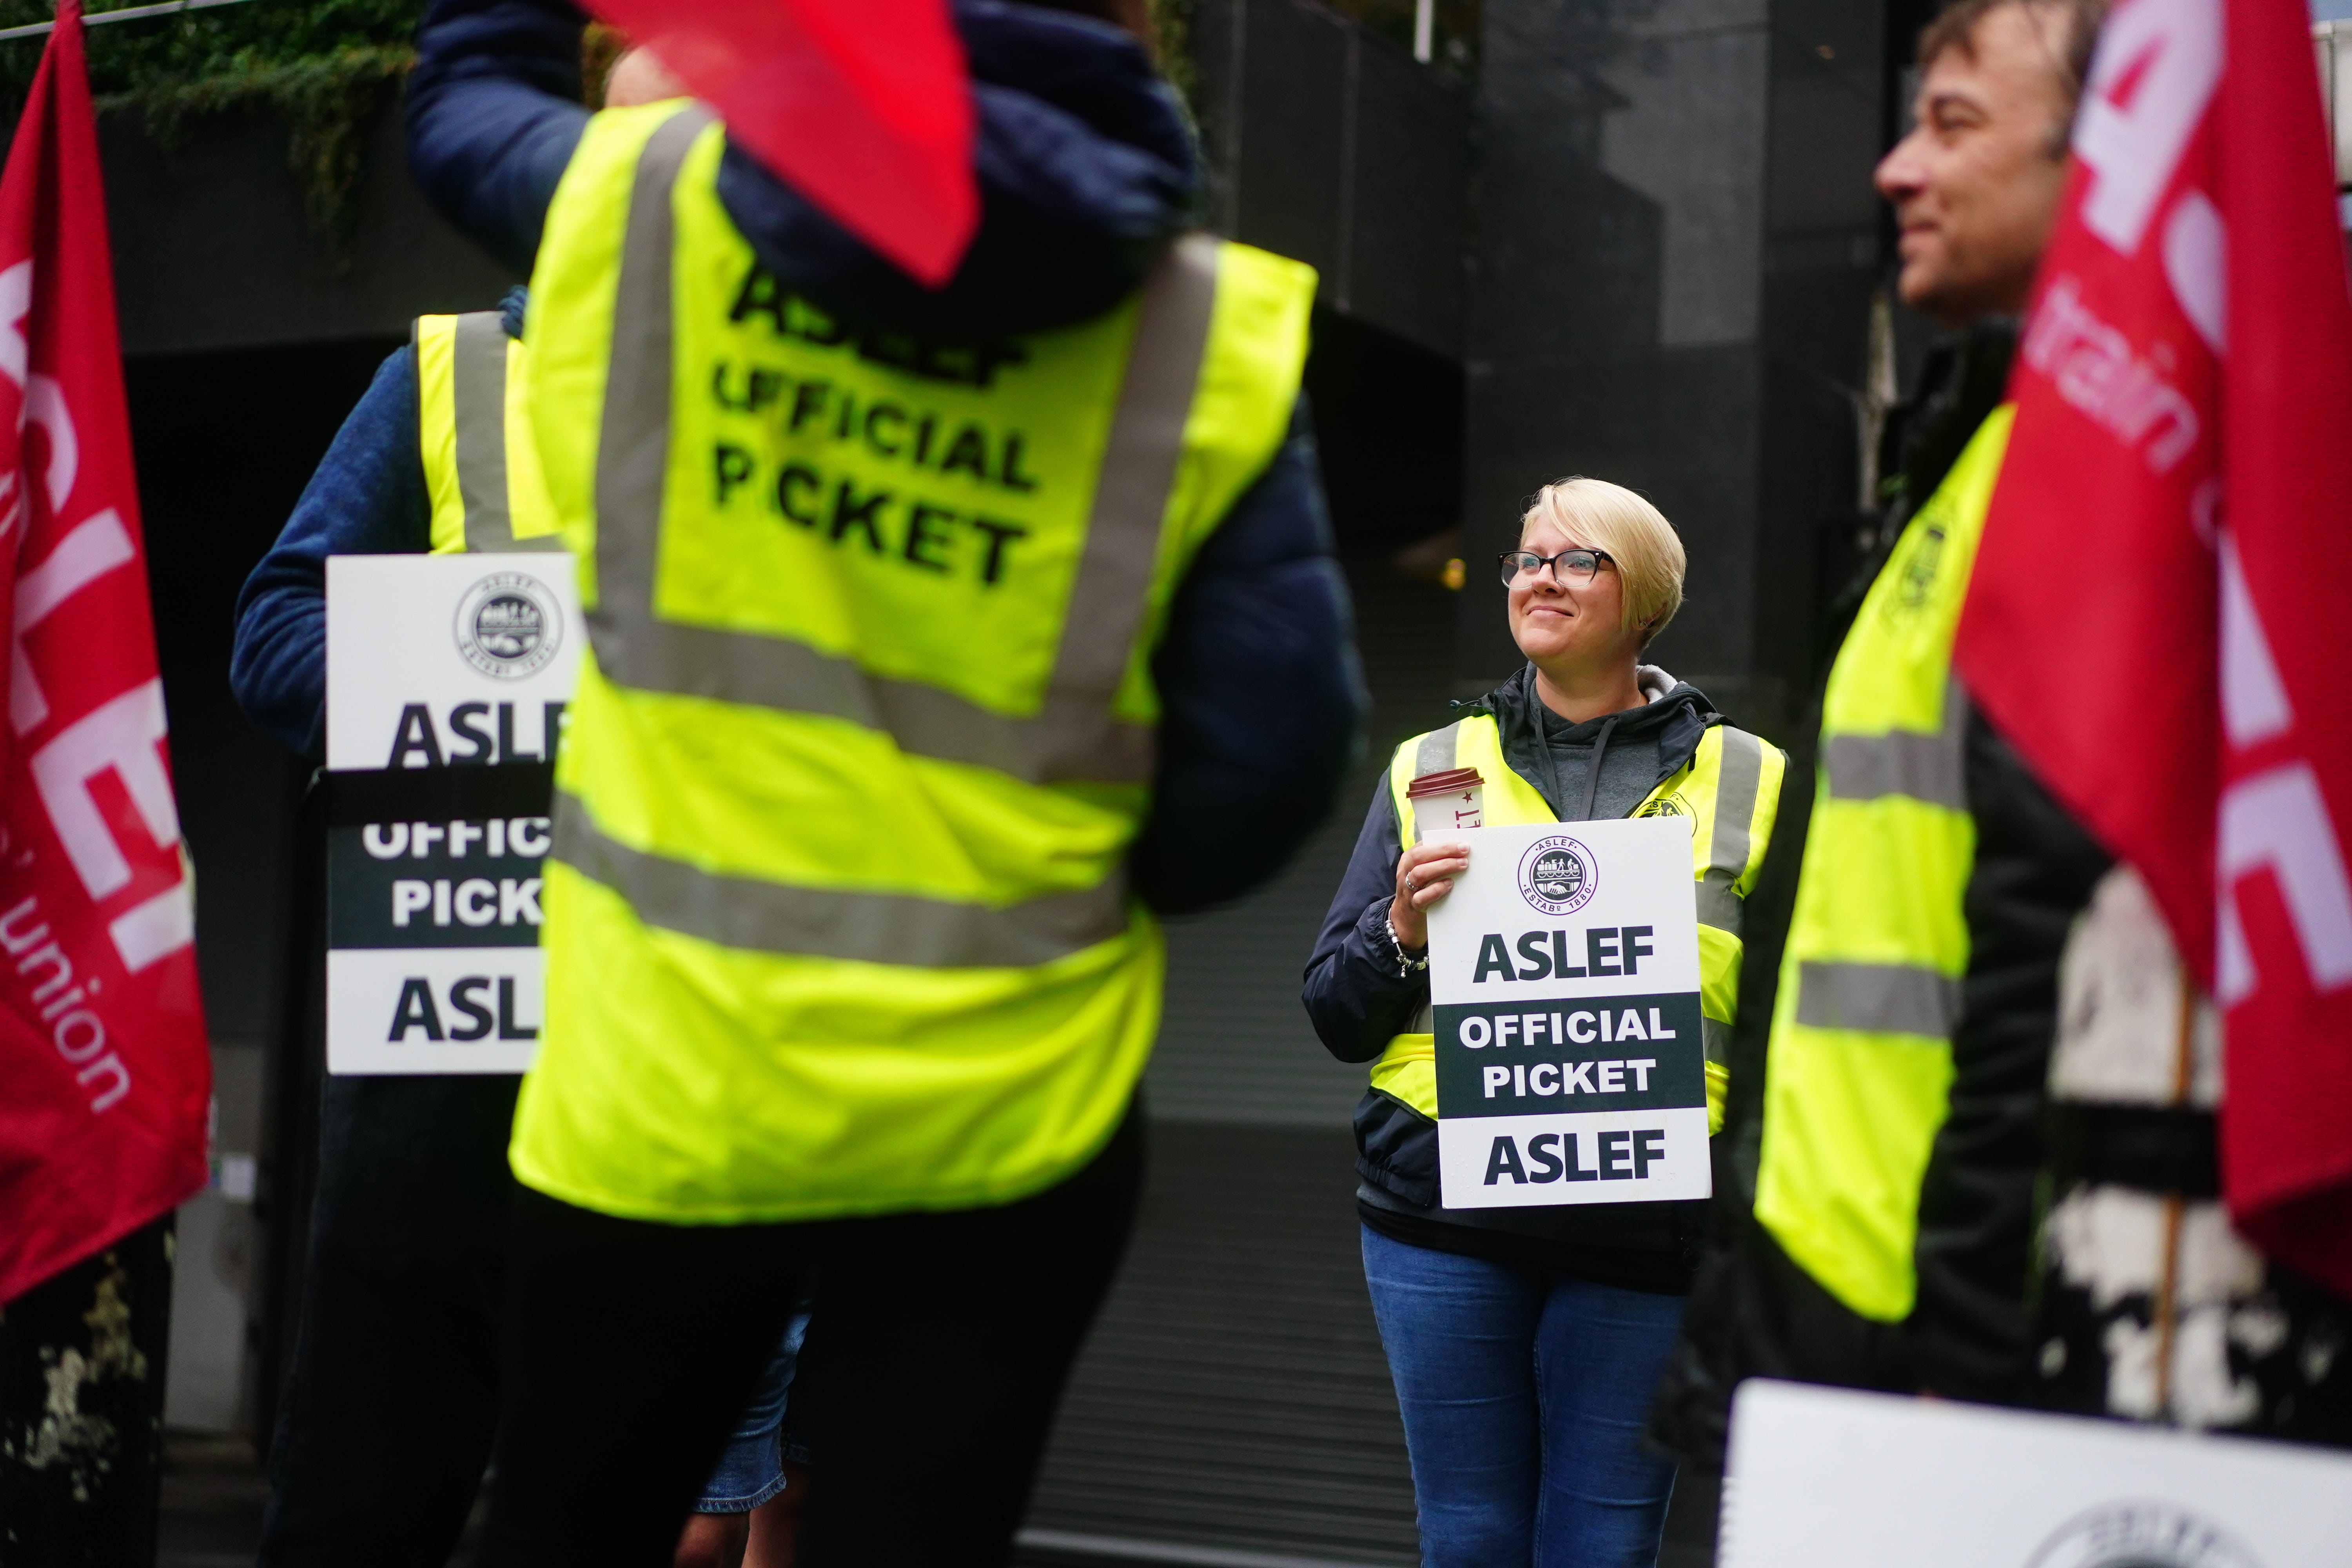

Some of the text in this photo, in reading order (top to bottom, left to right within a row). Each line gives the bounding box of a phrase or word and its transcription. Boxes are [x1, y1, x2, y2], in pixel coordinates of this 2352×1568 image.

[711, 439, 1032, 591] PCKET
[1538, 839, 1575, 851] ASLEF
[392, 878, 545, 927] PICK
[1569, 887, 1592, 909] 1880
[1472, 925, 1654, 983] ASLEF
[0, 896, 131, 1113] union
[387, 974, 539, 1043] ASL
[1459, 1007, 1676, 1049] OFFICIAL
[1483, 1058, 1657, 1098] PICKET
[1483, 1129, 1665, 1185] ASLEF
